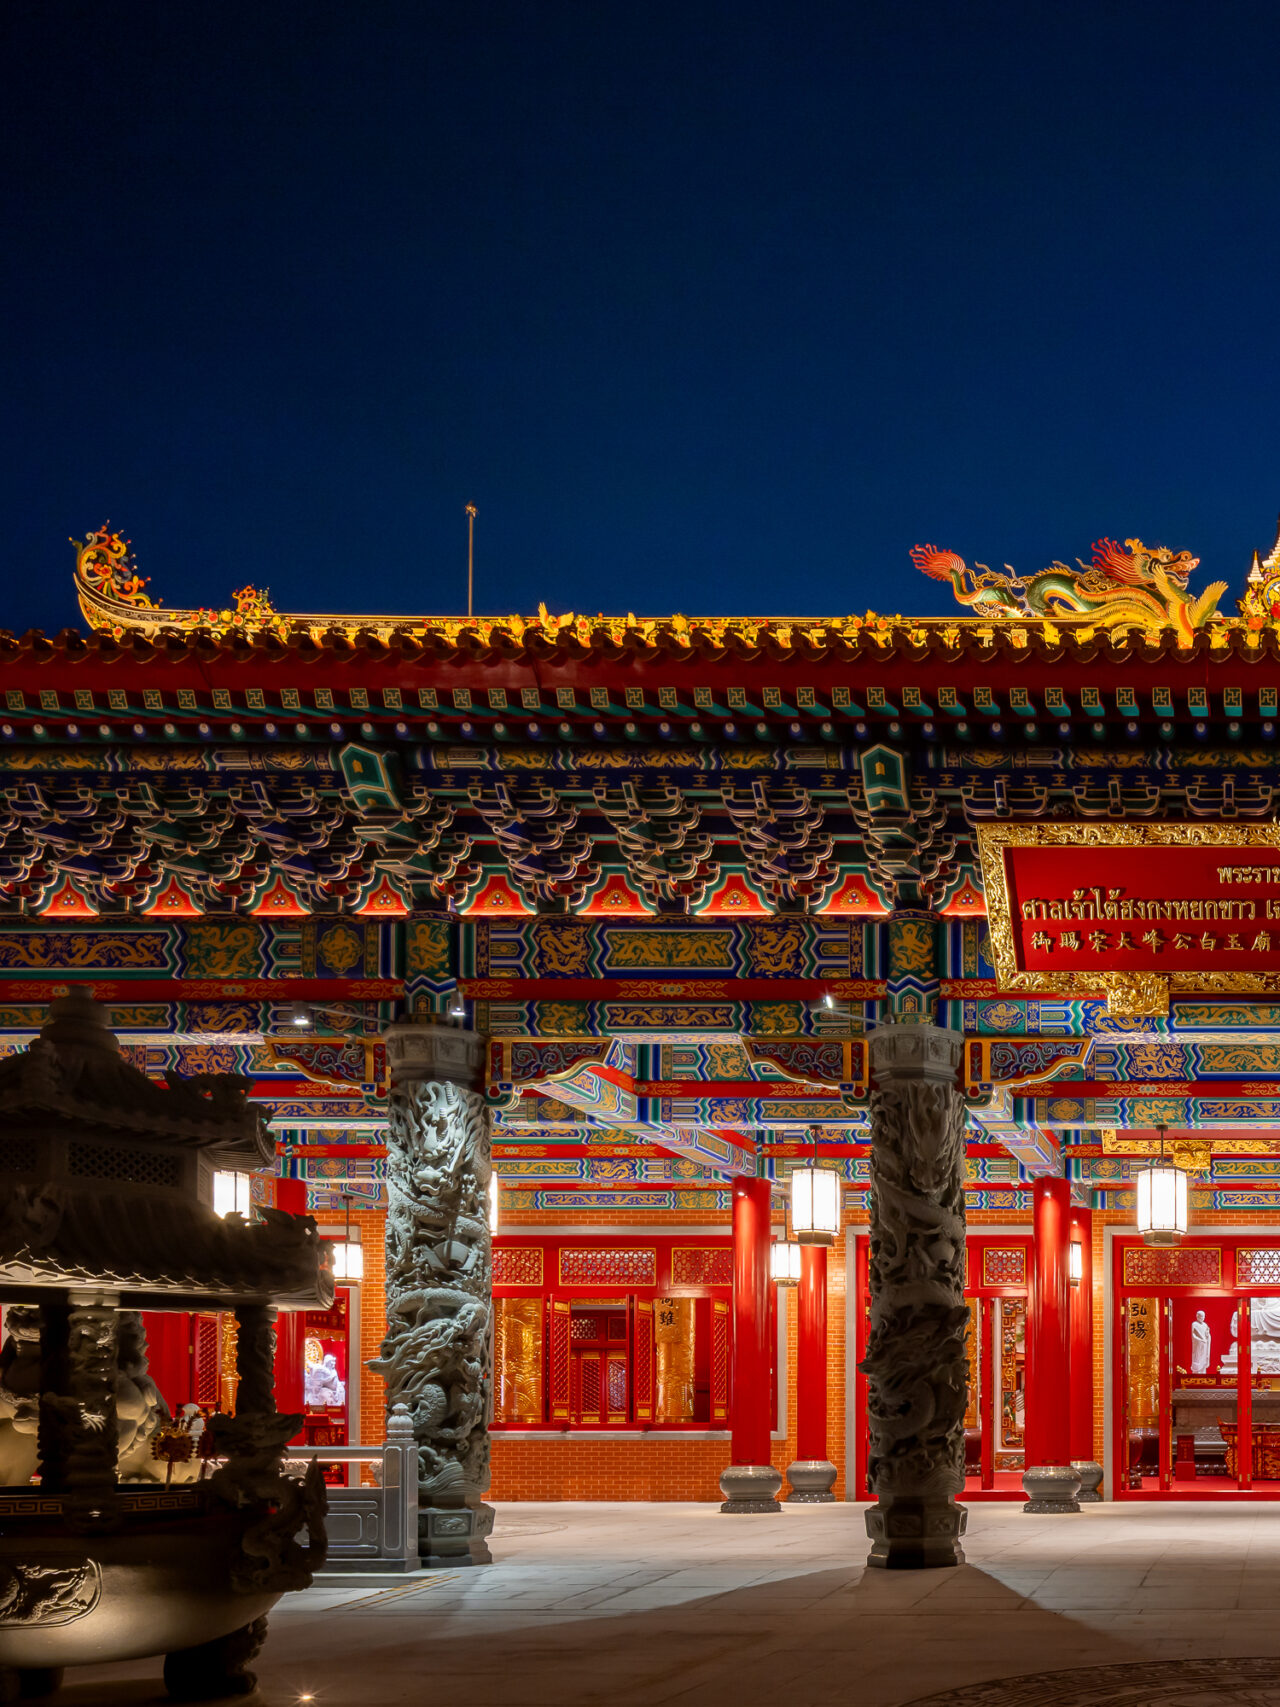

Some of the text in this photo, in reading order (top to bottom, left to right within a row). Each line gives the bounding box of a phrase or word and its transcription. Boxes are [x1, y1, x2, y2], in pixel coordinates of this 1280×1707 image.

[1022, 888, 1256, 921] ศาลเจ้าไต้ฮงกงหยกขาว
